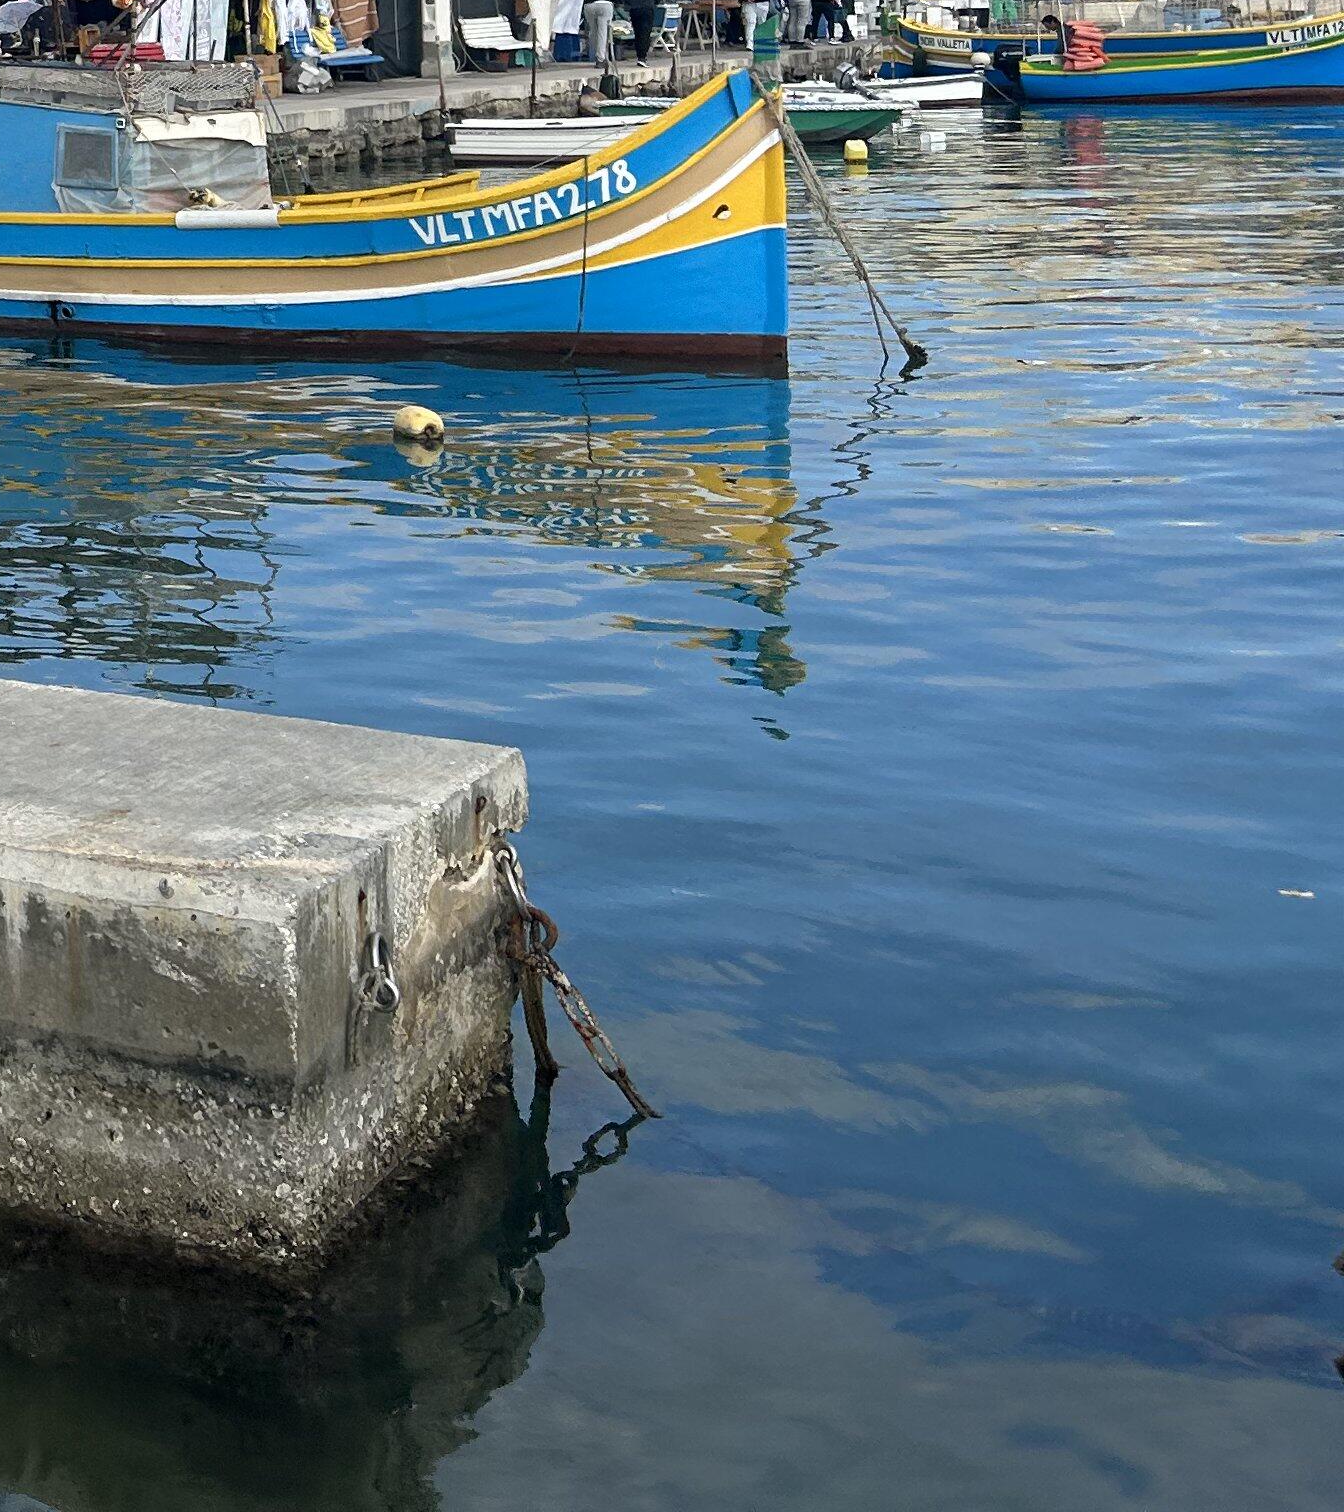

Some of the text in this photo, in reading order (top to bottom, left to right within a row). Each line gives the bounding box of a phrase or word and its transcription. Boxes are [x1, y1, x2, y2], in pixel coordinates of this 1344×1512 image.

[1269, 28, 1300, 44] VLT
[1306, 23, 1331, 40] MFA
[937, 38, 971, 50] VALLETTA
